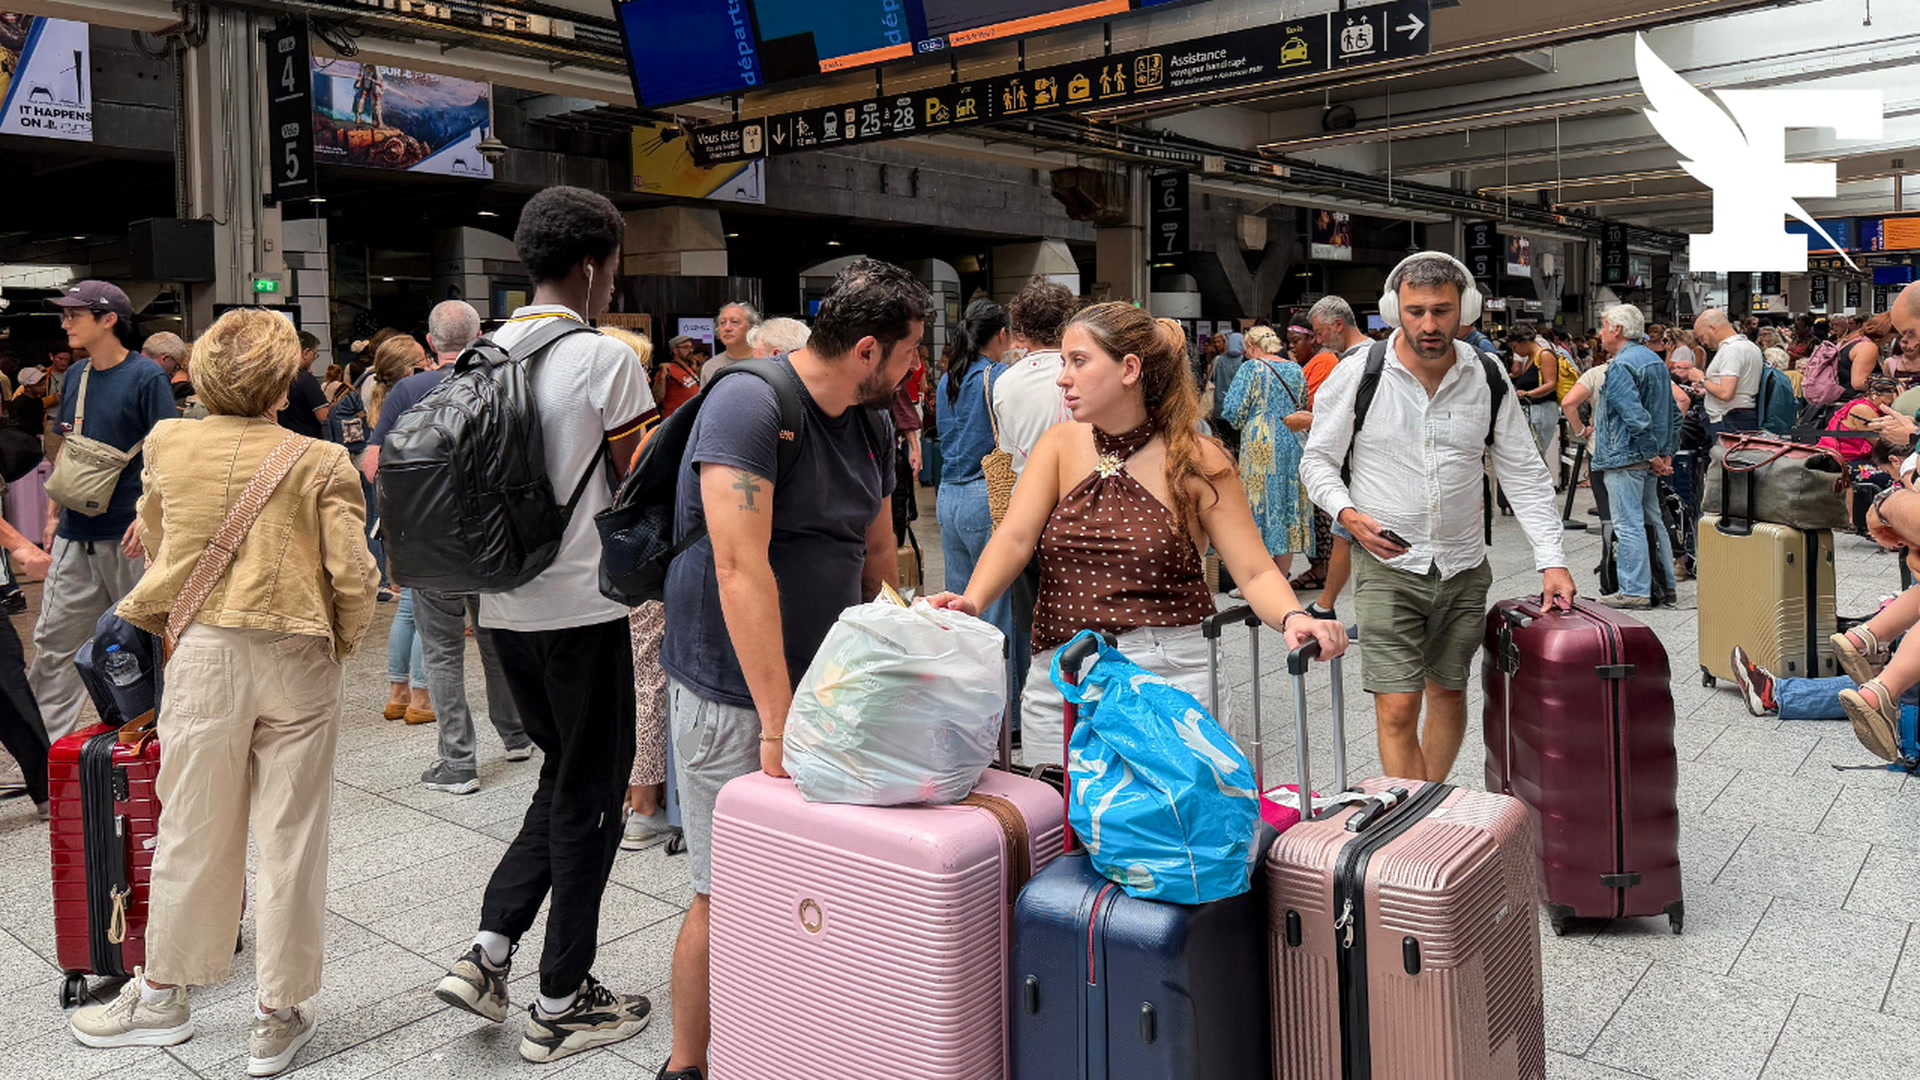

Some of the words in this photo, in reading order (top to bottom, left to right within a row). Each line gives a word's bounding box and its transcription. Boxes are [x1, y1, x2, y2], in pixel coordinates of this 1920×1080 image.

[1170, 49, 1227, 67] Assistance
[281, 55, 295, 92] 4
[20, 105, 31, 115] IT
[34, 106, 93, 122] HAPPENS
[860, 113, 880, 133] 25
[894, 107, 914, 128] 28
[21, 118, 41, 128] ON
[697, 133, 719, 145] Vous
[285, 141, 299, 179] 5
[1163, 188, 1175, 208] 6
[1163, 232, 1176, 251] 7
[1476, 232, 1486, 246] 8
[1607, 230, 1621, 241] 10
[1607, 254, 1621, 265] 17
[1476, 262, 1486, 276] 9
